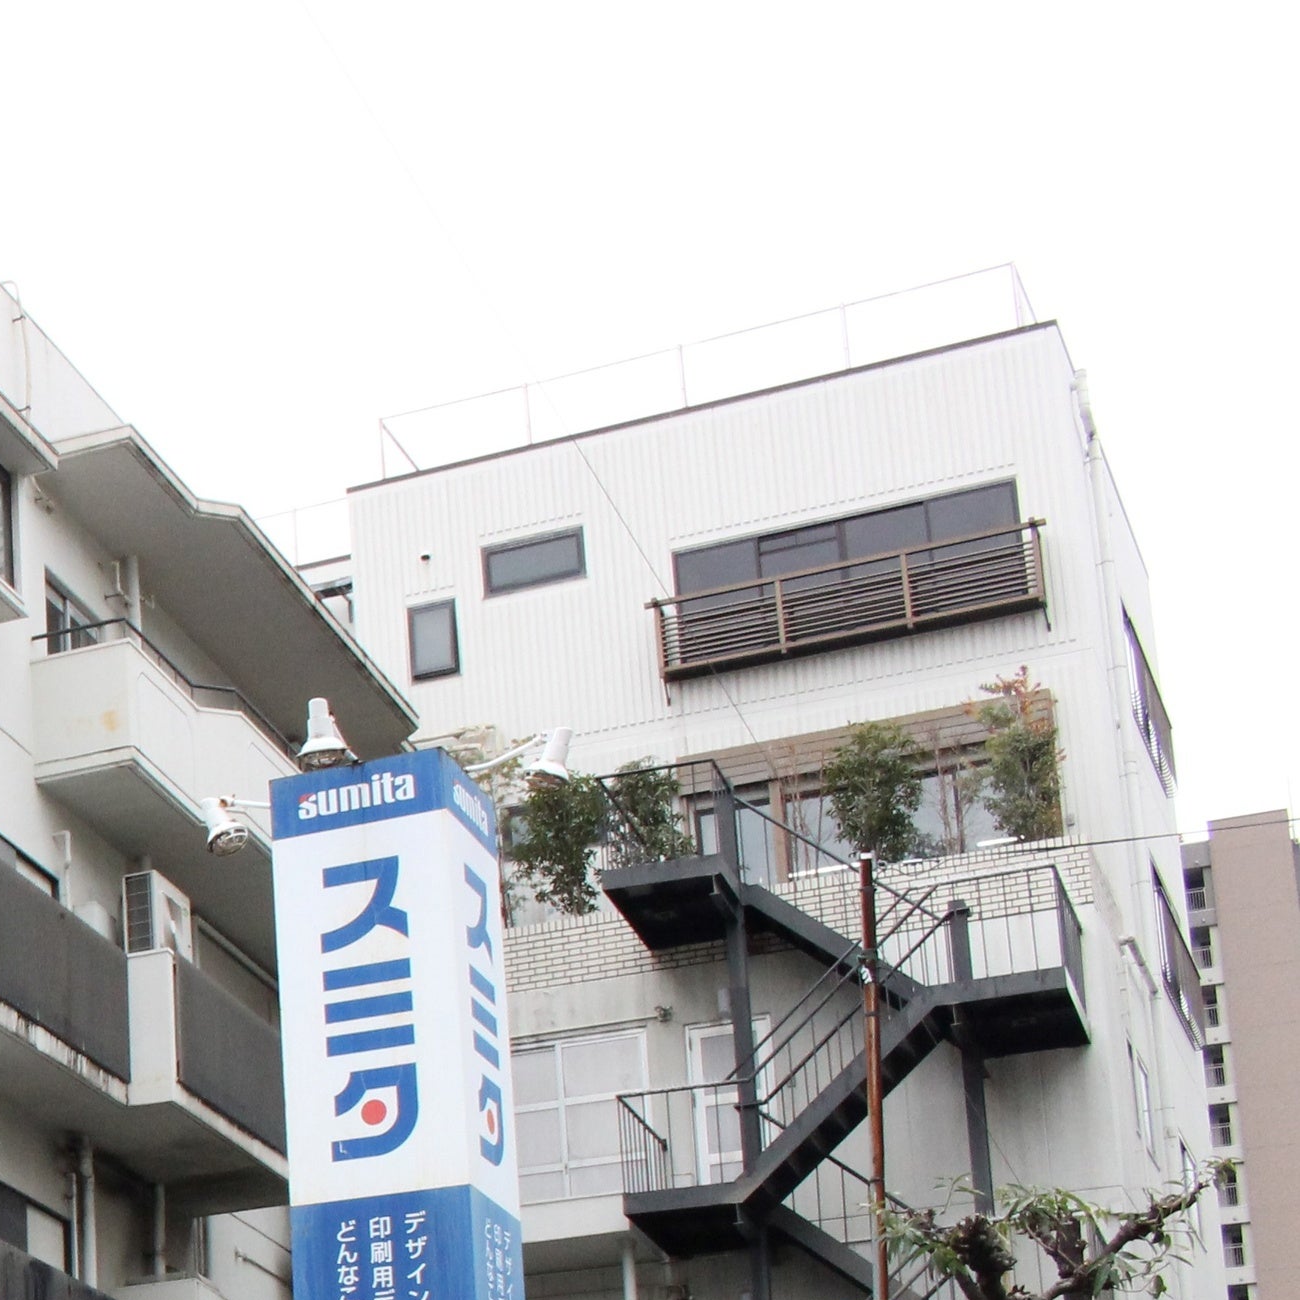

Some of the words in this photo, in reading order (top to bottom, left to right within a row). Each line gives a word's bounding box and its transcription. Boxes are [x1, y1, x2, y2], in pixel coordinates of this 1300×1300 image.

[298, 772, 416, 820] sumita
[320, 855, 419, 1162] スミタ
[464, 863, 504, 1167] スミタ
